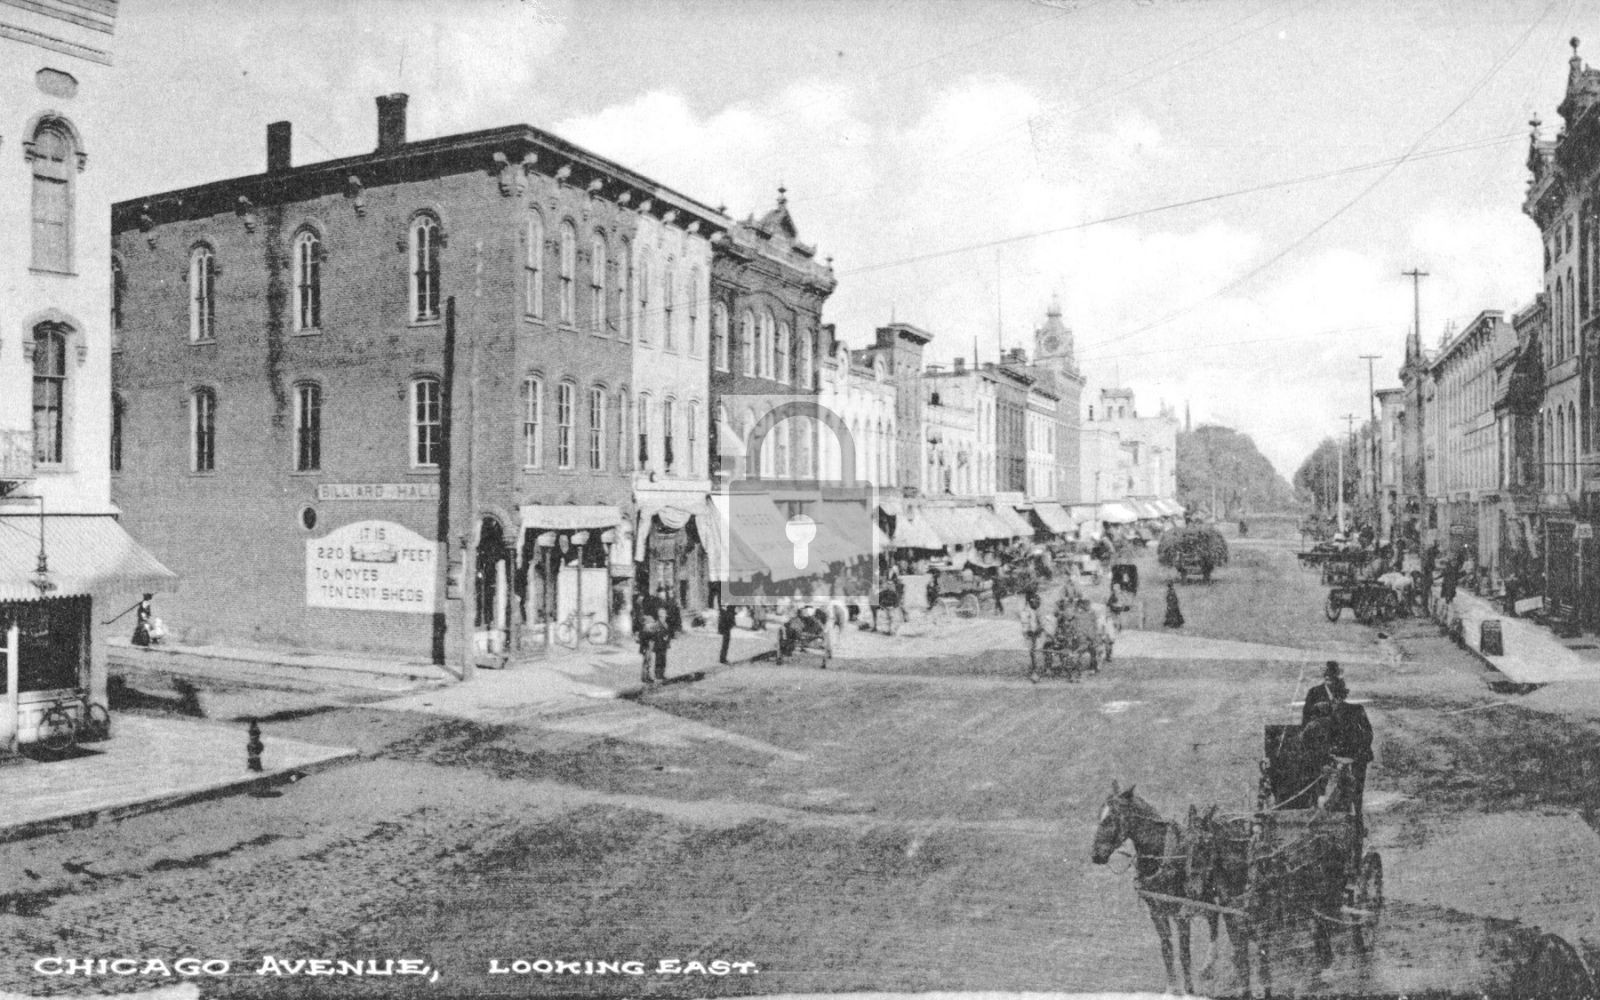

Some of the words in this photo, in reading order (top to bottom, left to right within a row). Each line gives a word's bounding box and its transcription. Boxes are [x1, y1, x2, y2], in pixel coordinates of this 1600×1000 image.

[397, 485, 439, 497] HALL
[360, 527, 370, 540] IT
[375, 527, 386, 540] IS
[317, 547, 344, 559] 220
[402, 549, 431, 562] FEET
[334, 568, 379, 582] NOYES
[321, 585, 343, 599] TEN
[347, 586, 377, 600] CENT
[381, 588, 424, 602] SHEDS
